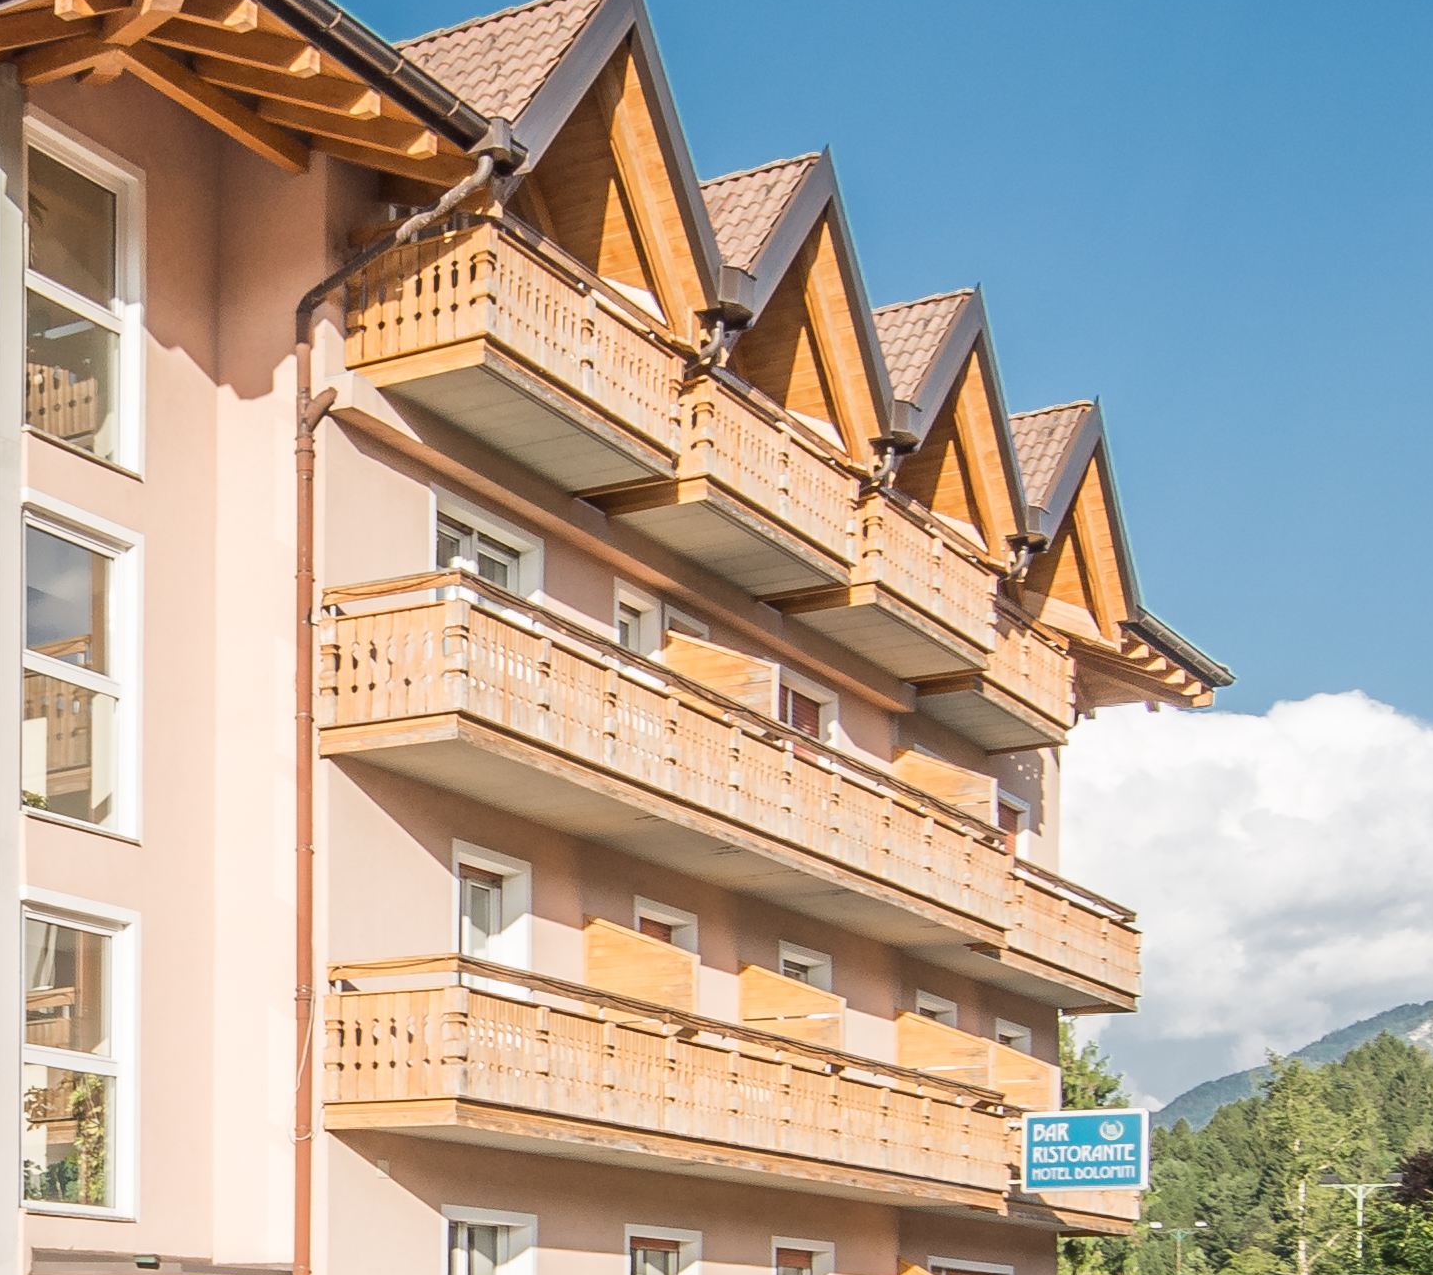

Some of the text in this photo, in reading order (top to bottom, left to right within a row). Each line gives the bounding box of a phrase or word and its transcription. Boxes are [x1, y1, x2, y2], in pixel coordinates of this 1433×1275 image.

[1032, 1123, 1070, 1142] BAR
[1032, 1144, 1136, 1163] RISTORANTE
[1074, 1165, 1136, 1180] DOLOMITI
